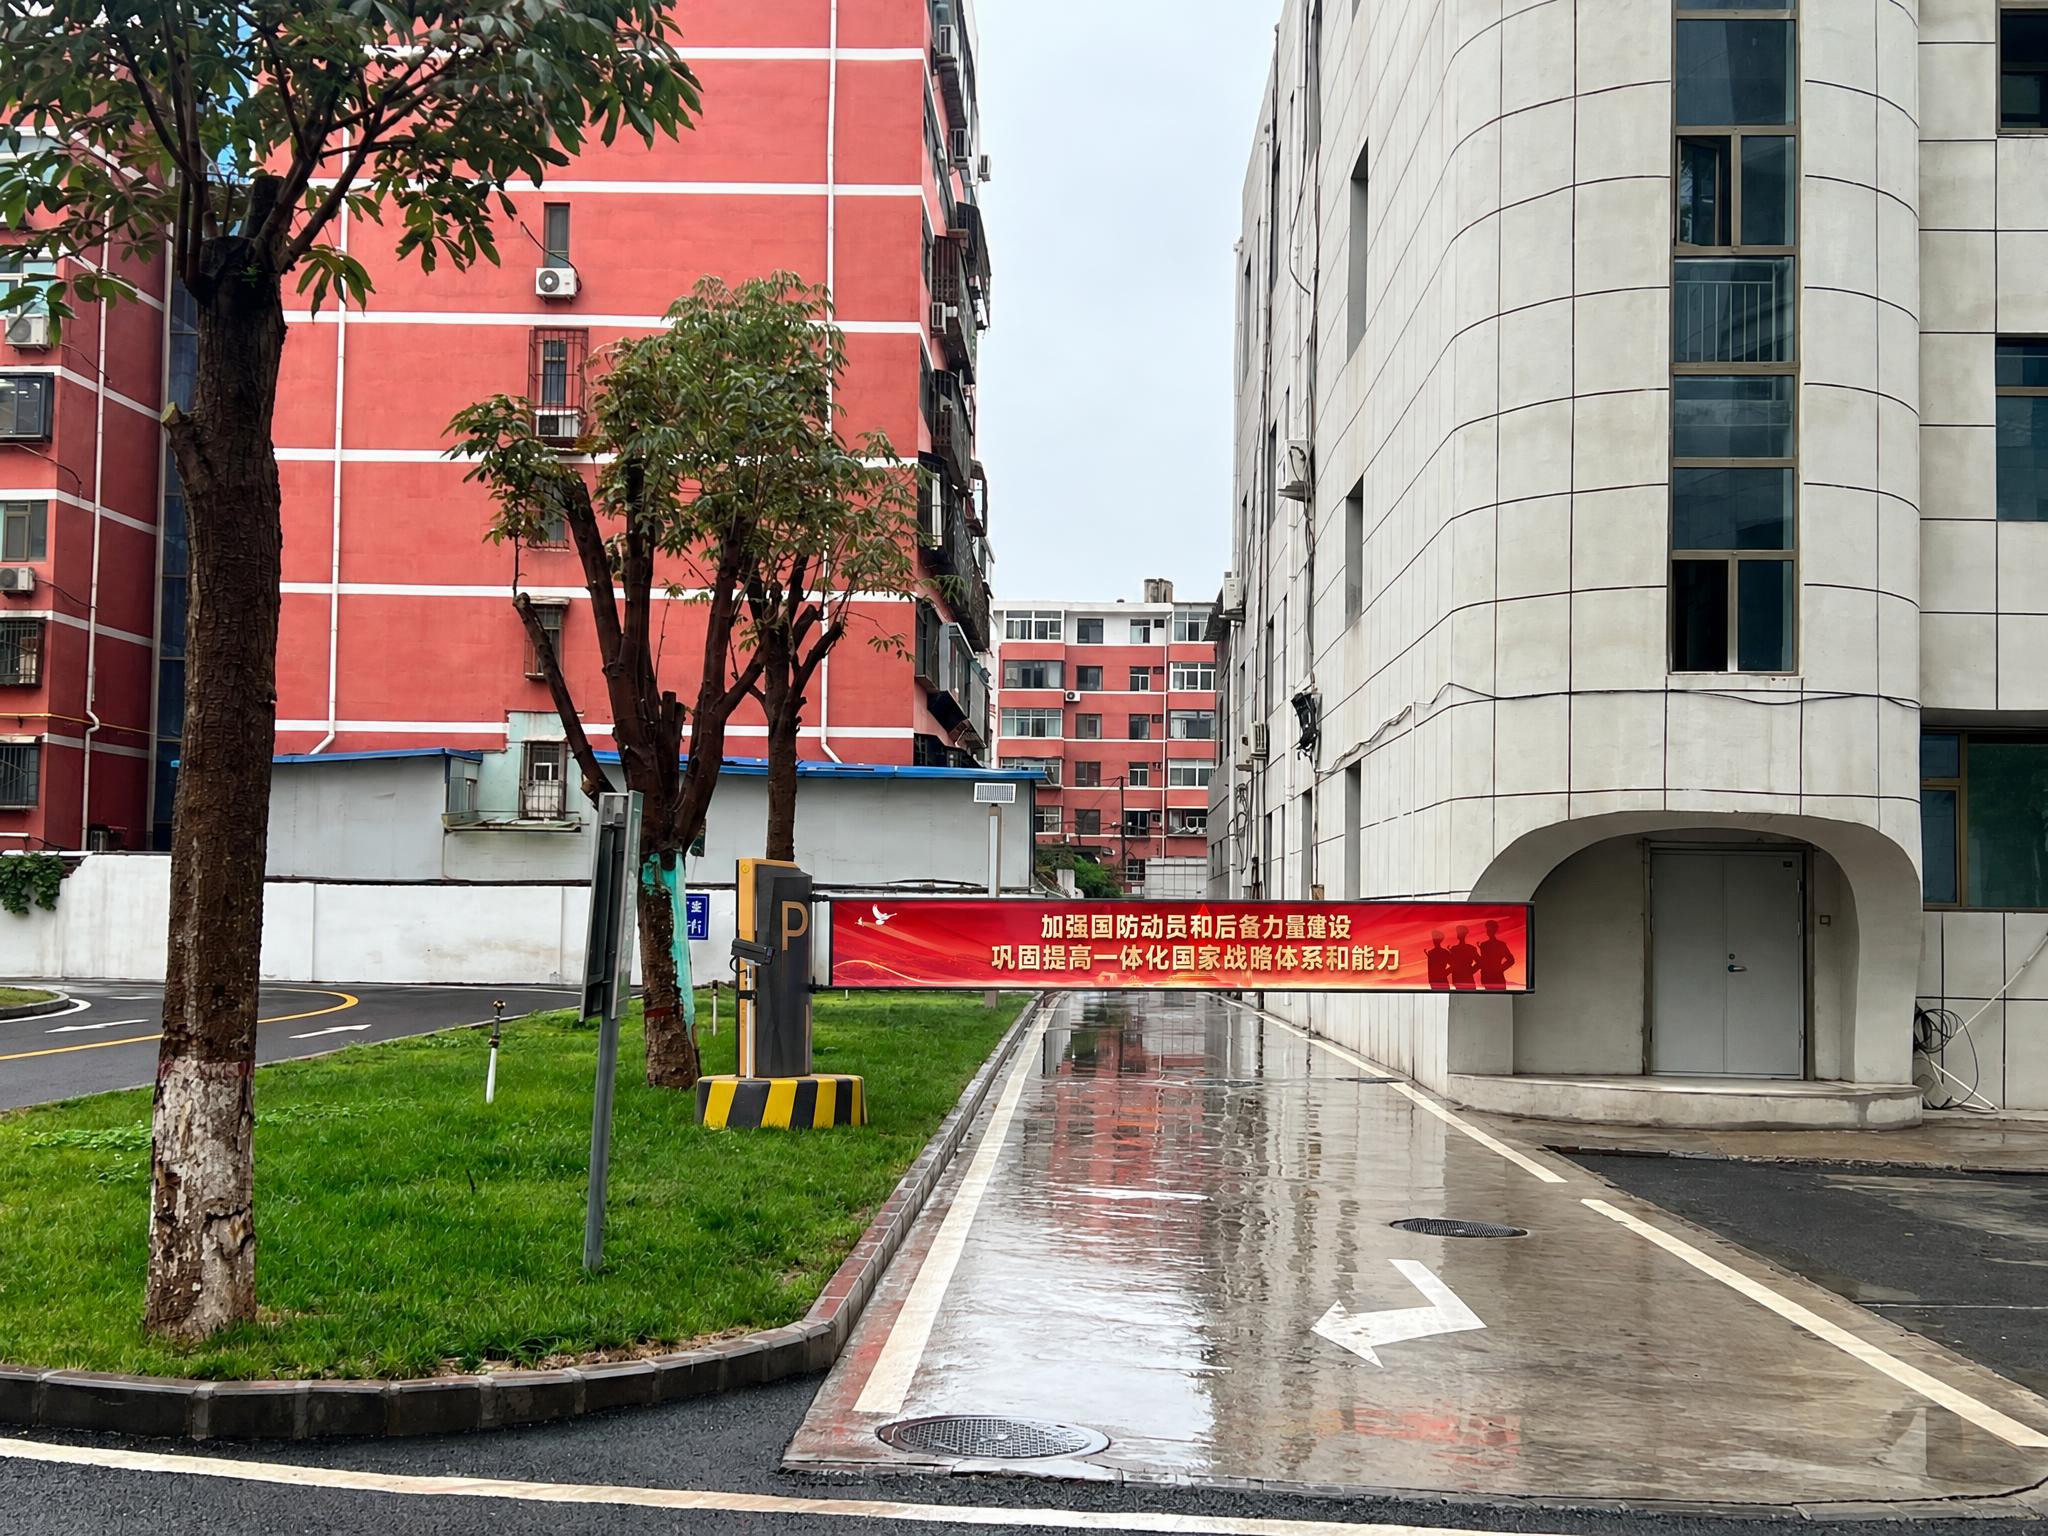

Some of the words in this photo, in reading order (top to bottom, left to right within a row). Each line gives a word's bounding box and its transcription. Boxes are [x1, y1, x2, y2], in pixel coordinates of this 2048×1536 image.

[781, 900, 809, 951] P
[1041, 913, 1352, 940] 加强国防动员和后备力量建设
[991, 944, 1400, 972] 巩固提高一体化国家战略体系和能力
